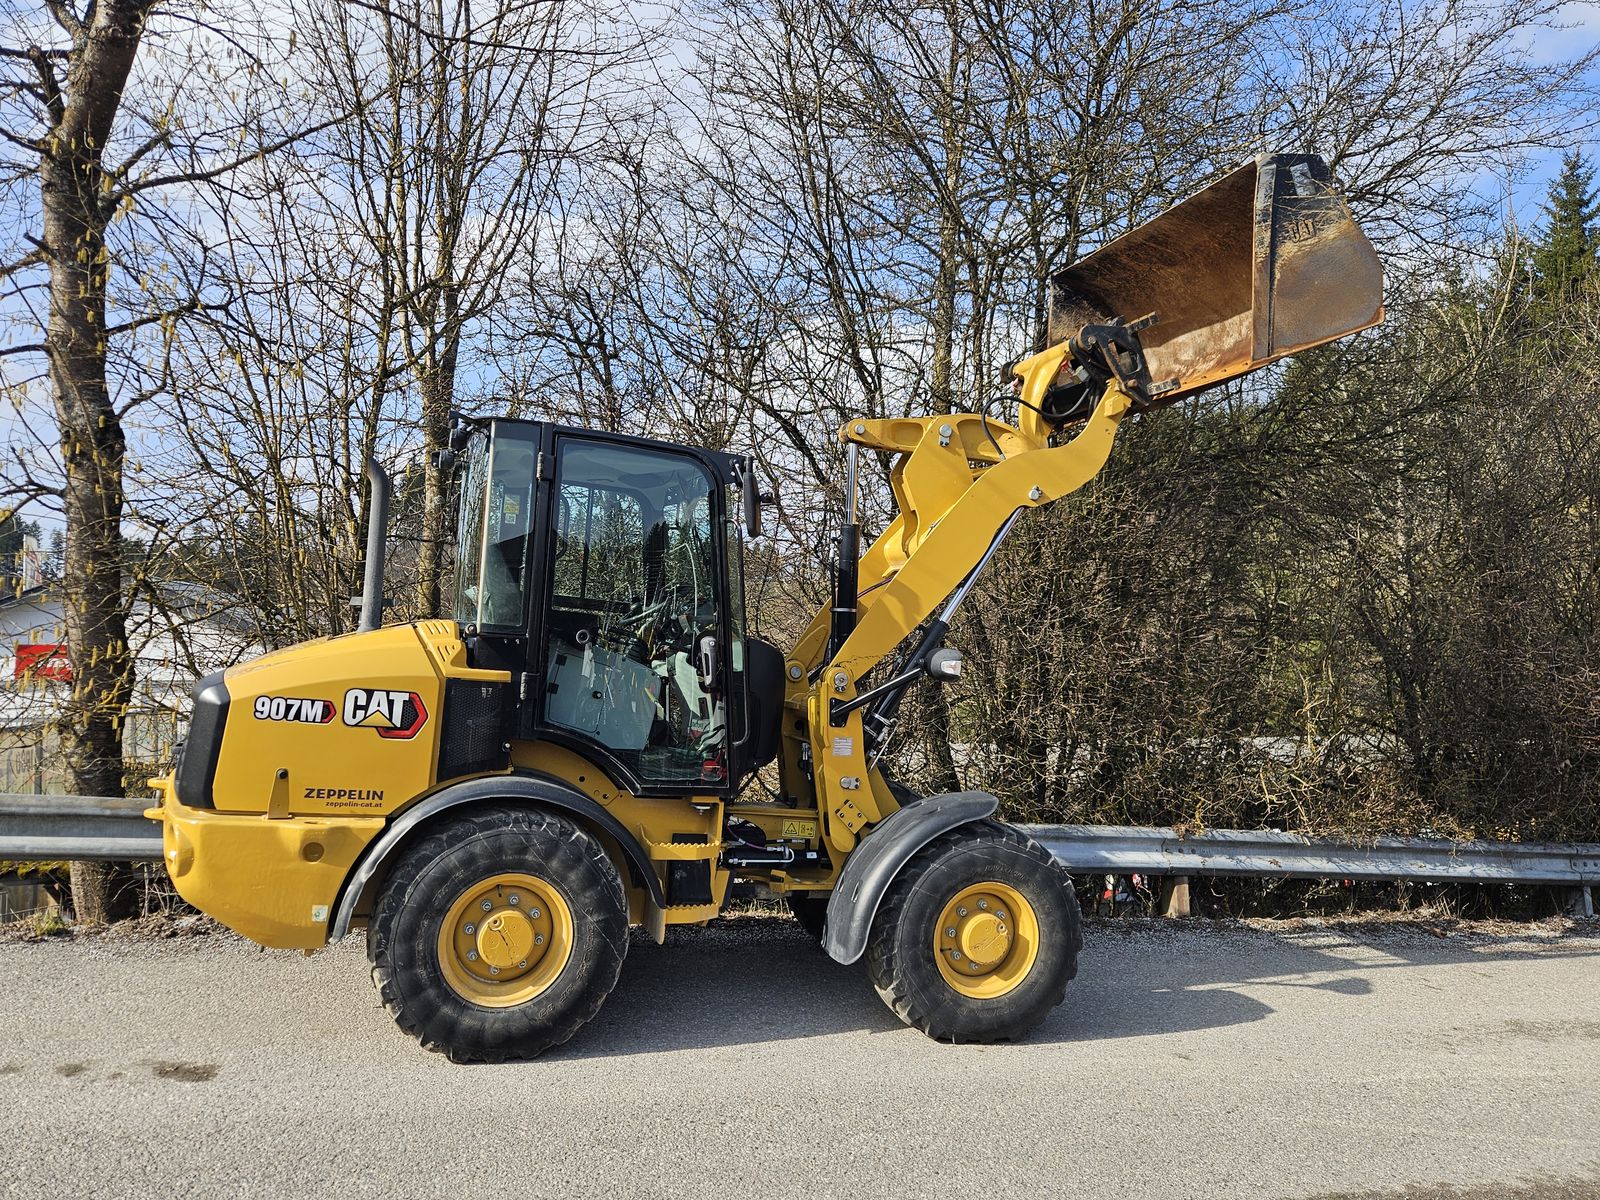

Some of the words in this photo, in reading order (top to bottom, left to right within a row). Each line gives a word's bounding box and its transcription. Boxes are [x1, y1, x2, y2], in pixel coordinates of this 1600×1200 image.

[255, 697, 324, 722] 907M
[344, 688, 410, 728] CAT
[304, 788, 384, 800] ZEPPELIN
